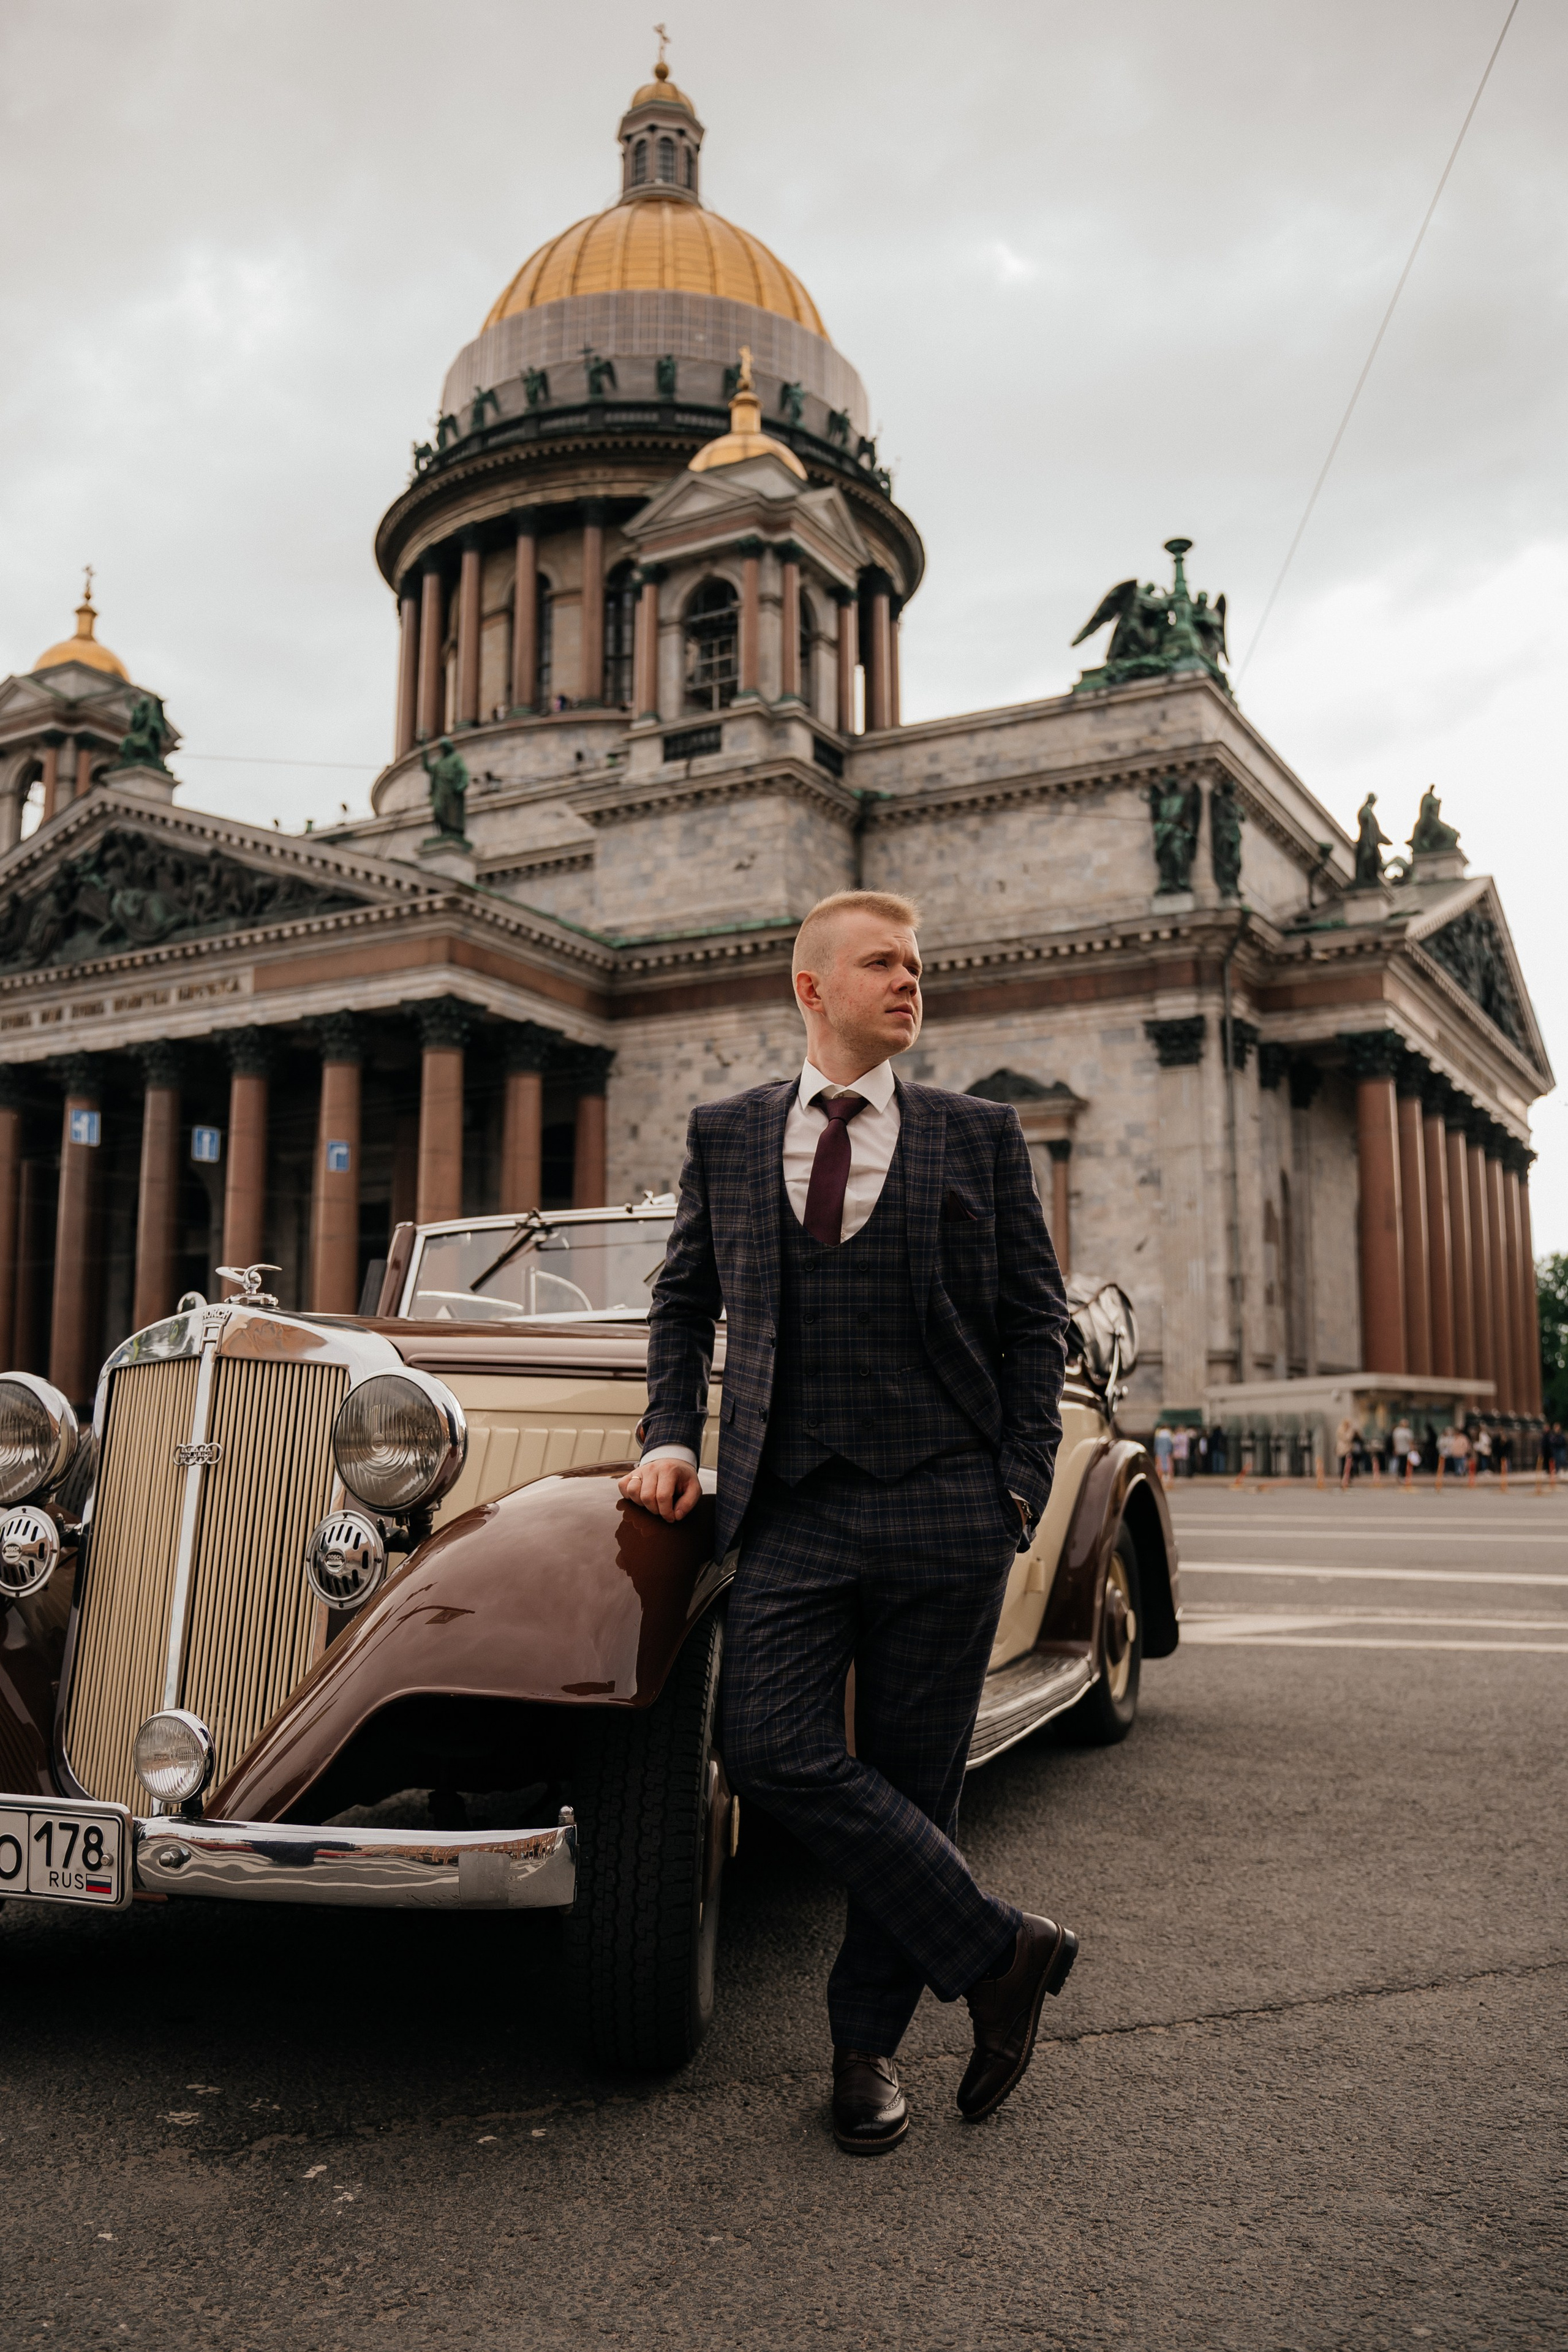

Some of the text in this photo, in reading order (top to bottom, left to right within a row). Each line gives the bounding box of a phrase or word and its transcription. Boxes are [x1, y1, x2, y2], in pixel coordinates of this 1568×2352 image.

[202, 1308, 232, 1320] HORCH
[34, 1820, 104, 1872] 178
[49, 1871, 85, 1890] RUS
